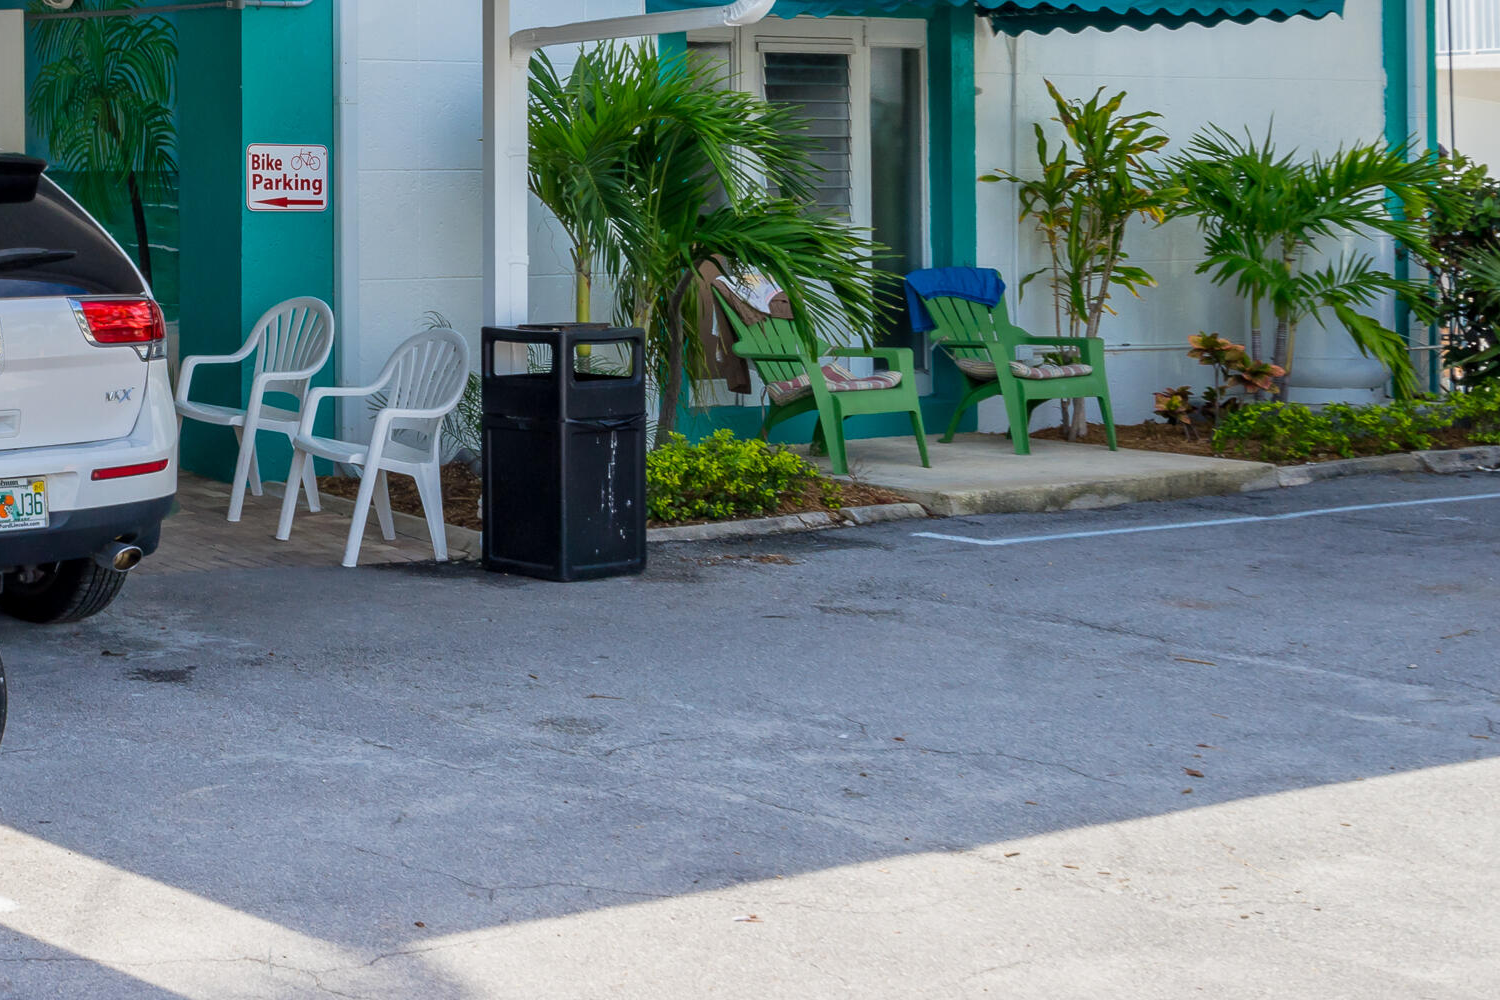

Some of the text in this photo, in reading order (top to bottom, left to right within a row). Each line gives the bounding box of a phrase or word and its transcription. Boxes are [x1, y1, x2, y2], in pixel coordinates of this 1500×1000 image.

[251, 153, 282, 171] Bike
[252, 173, 323, 195] Parking
[16, 493, 43, 516] J36
